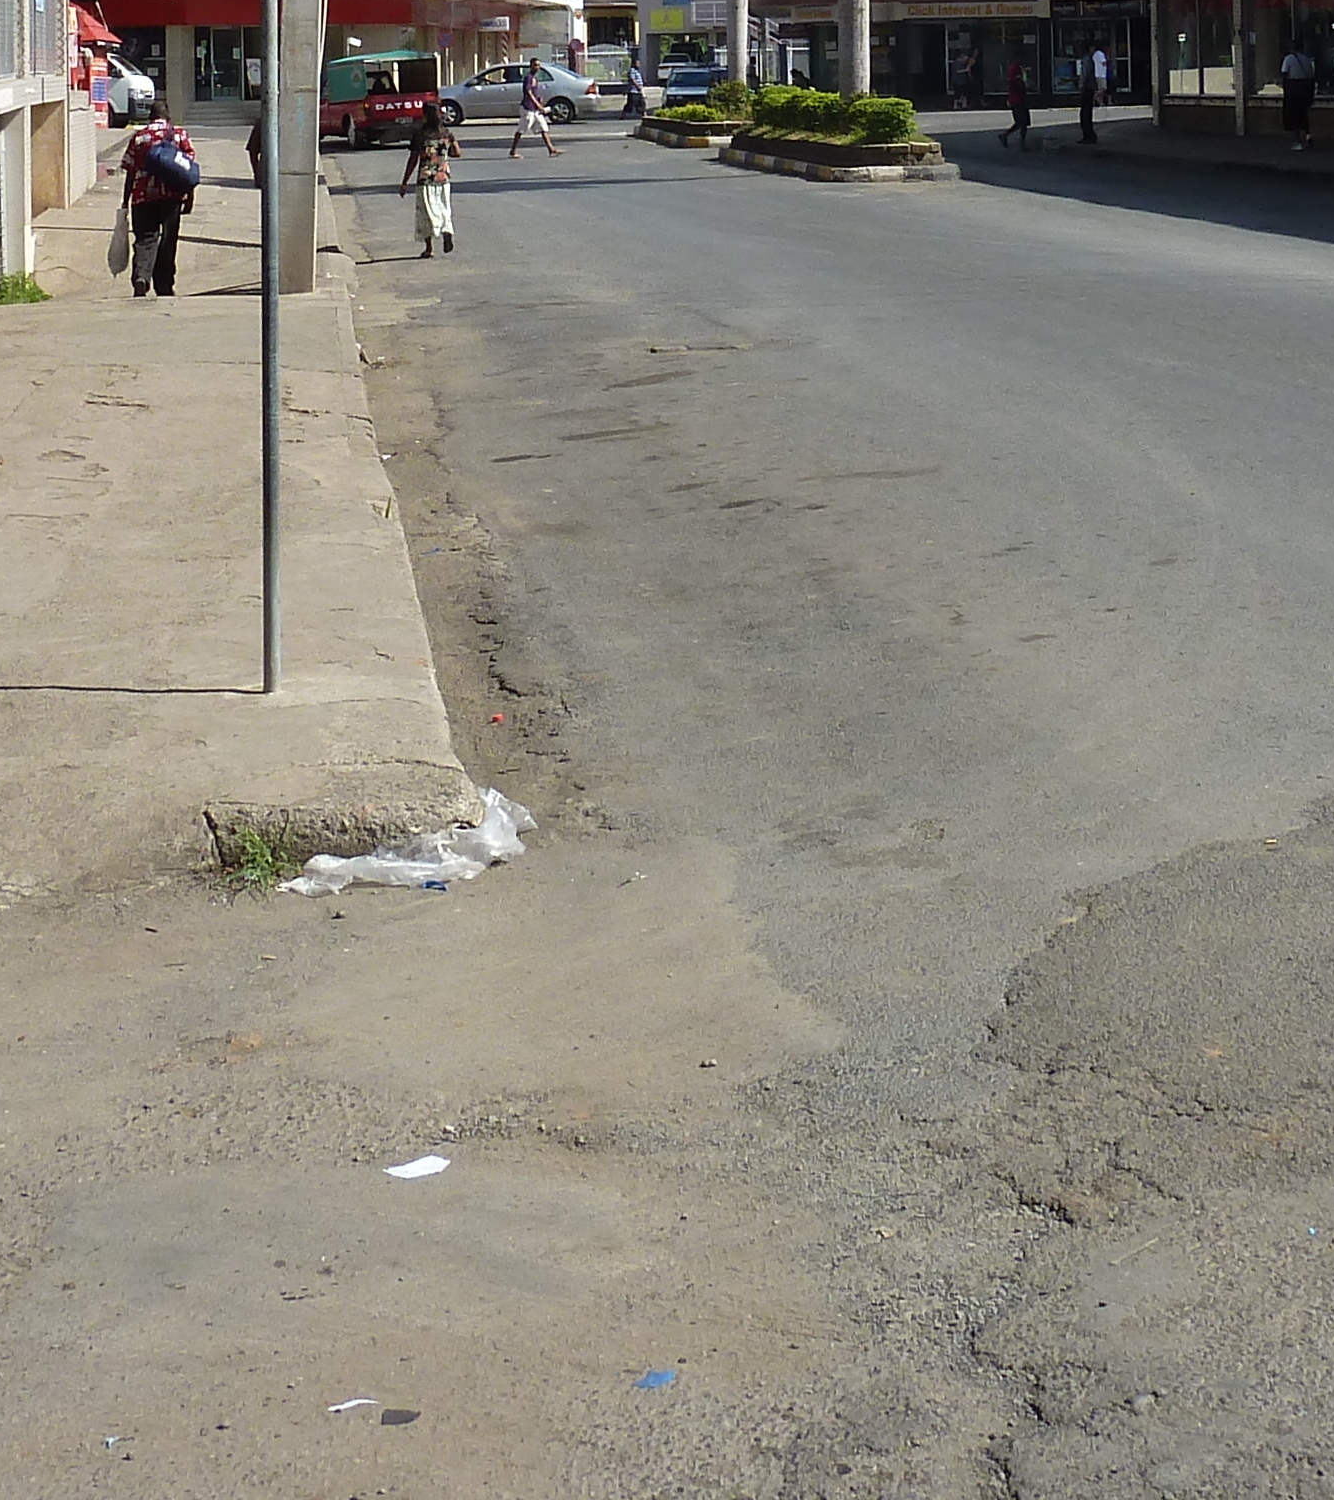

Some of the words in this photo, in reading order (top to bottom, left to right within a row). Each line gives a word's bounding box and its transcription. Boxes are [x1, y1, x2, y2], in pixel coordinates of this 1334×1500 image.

[908, 5, 934, 15] Click
[939, 4, 980, 15] Internet
[985, 4, 993, 14] &
[997, 3, 1034, 14] Games
[375, 100, 423, 111] DATSU
